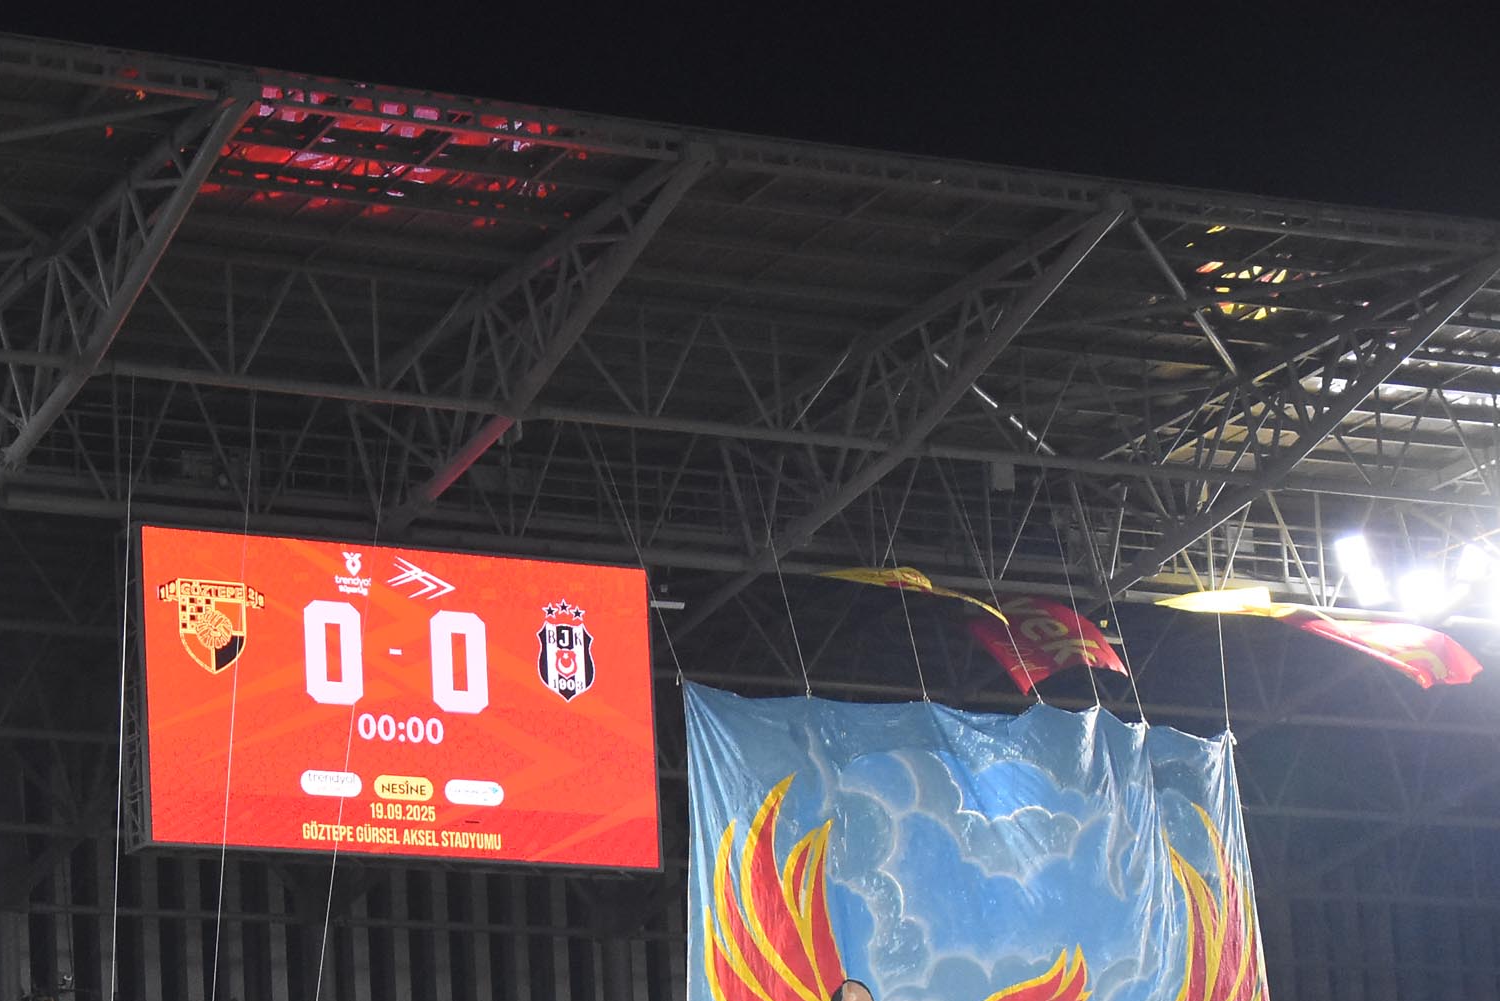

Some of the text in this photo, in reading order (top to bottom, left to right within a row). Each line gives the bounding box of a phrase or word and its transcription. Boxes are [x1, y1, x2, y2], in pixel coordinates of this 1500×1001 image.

[303, 599, 364, 706] 0
[429, 609, 489, 714] 0
[357, 712, 444, 745] 00:00
[370, 802, 437, 822] 19.09.2025
[301, 819, 503, 850] GÖZTEPE GÜRSEL AKSEL STADYUMU
